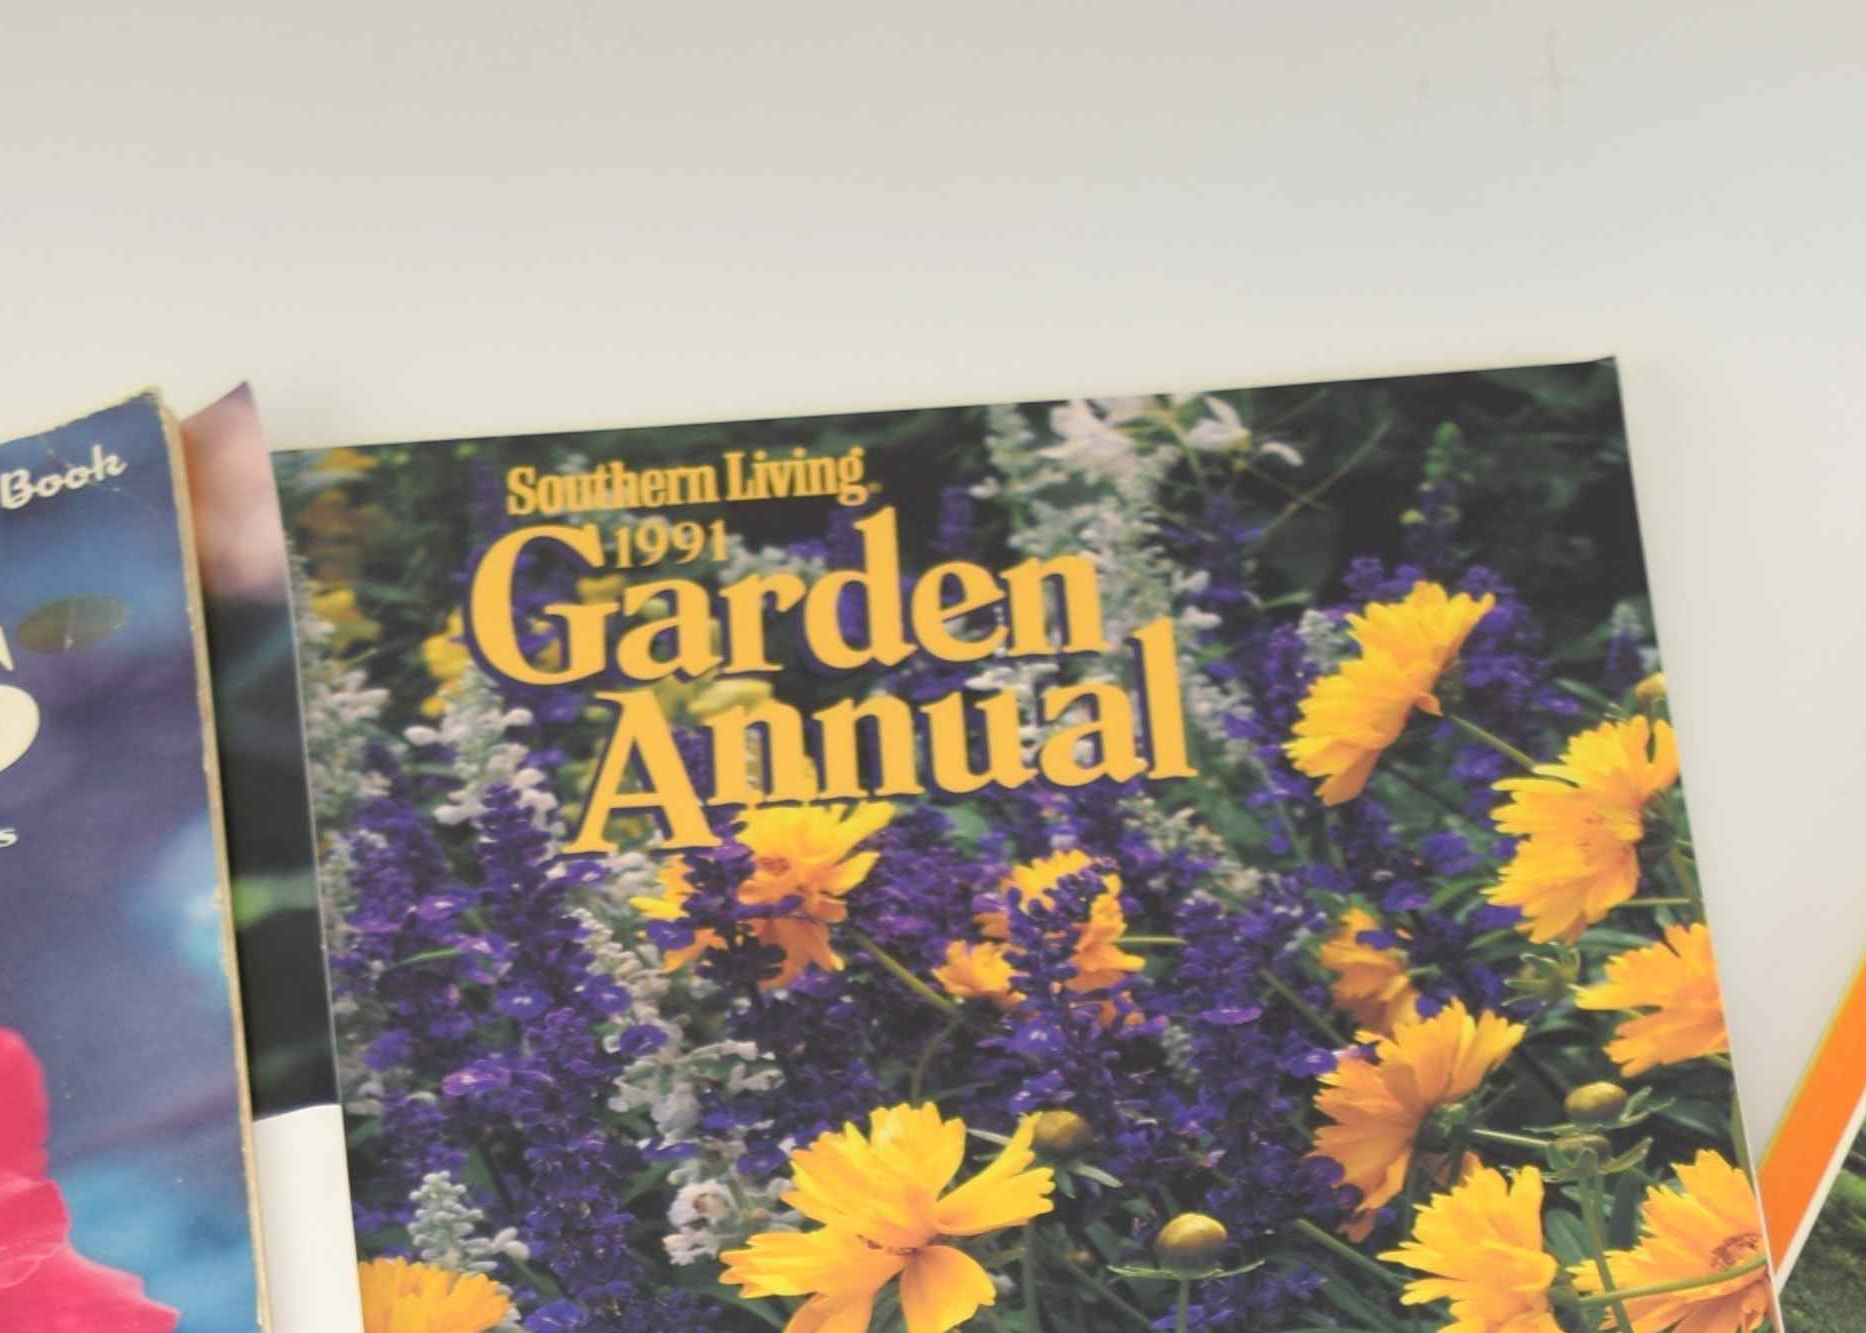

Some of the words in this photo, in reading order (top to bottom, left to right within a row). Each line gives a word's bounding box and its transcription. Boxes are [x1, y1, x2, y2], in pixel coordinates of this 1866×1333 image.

[506, 460, 719, 515] Southern
[615, 519, 728, 568] 1991
[470, 508, 1109, 685] Garden
[560, 619, 1198, 855] Annual
